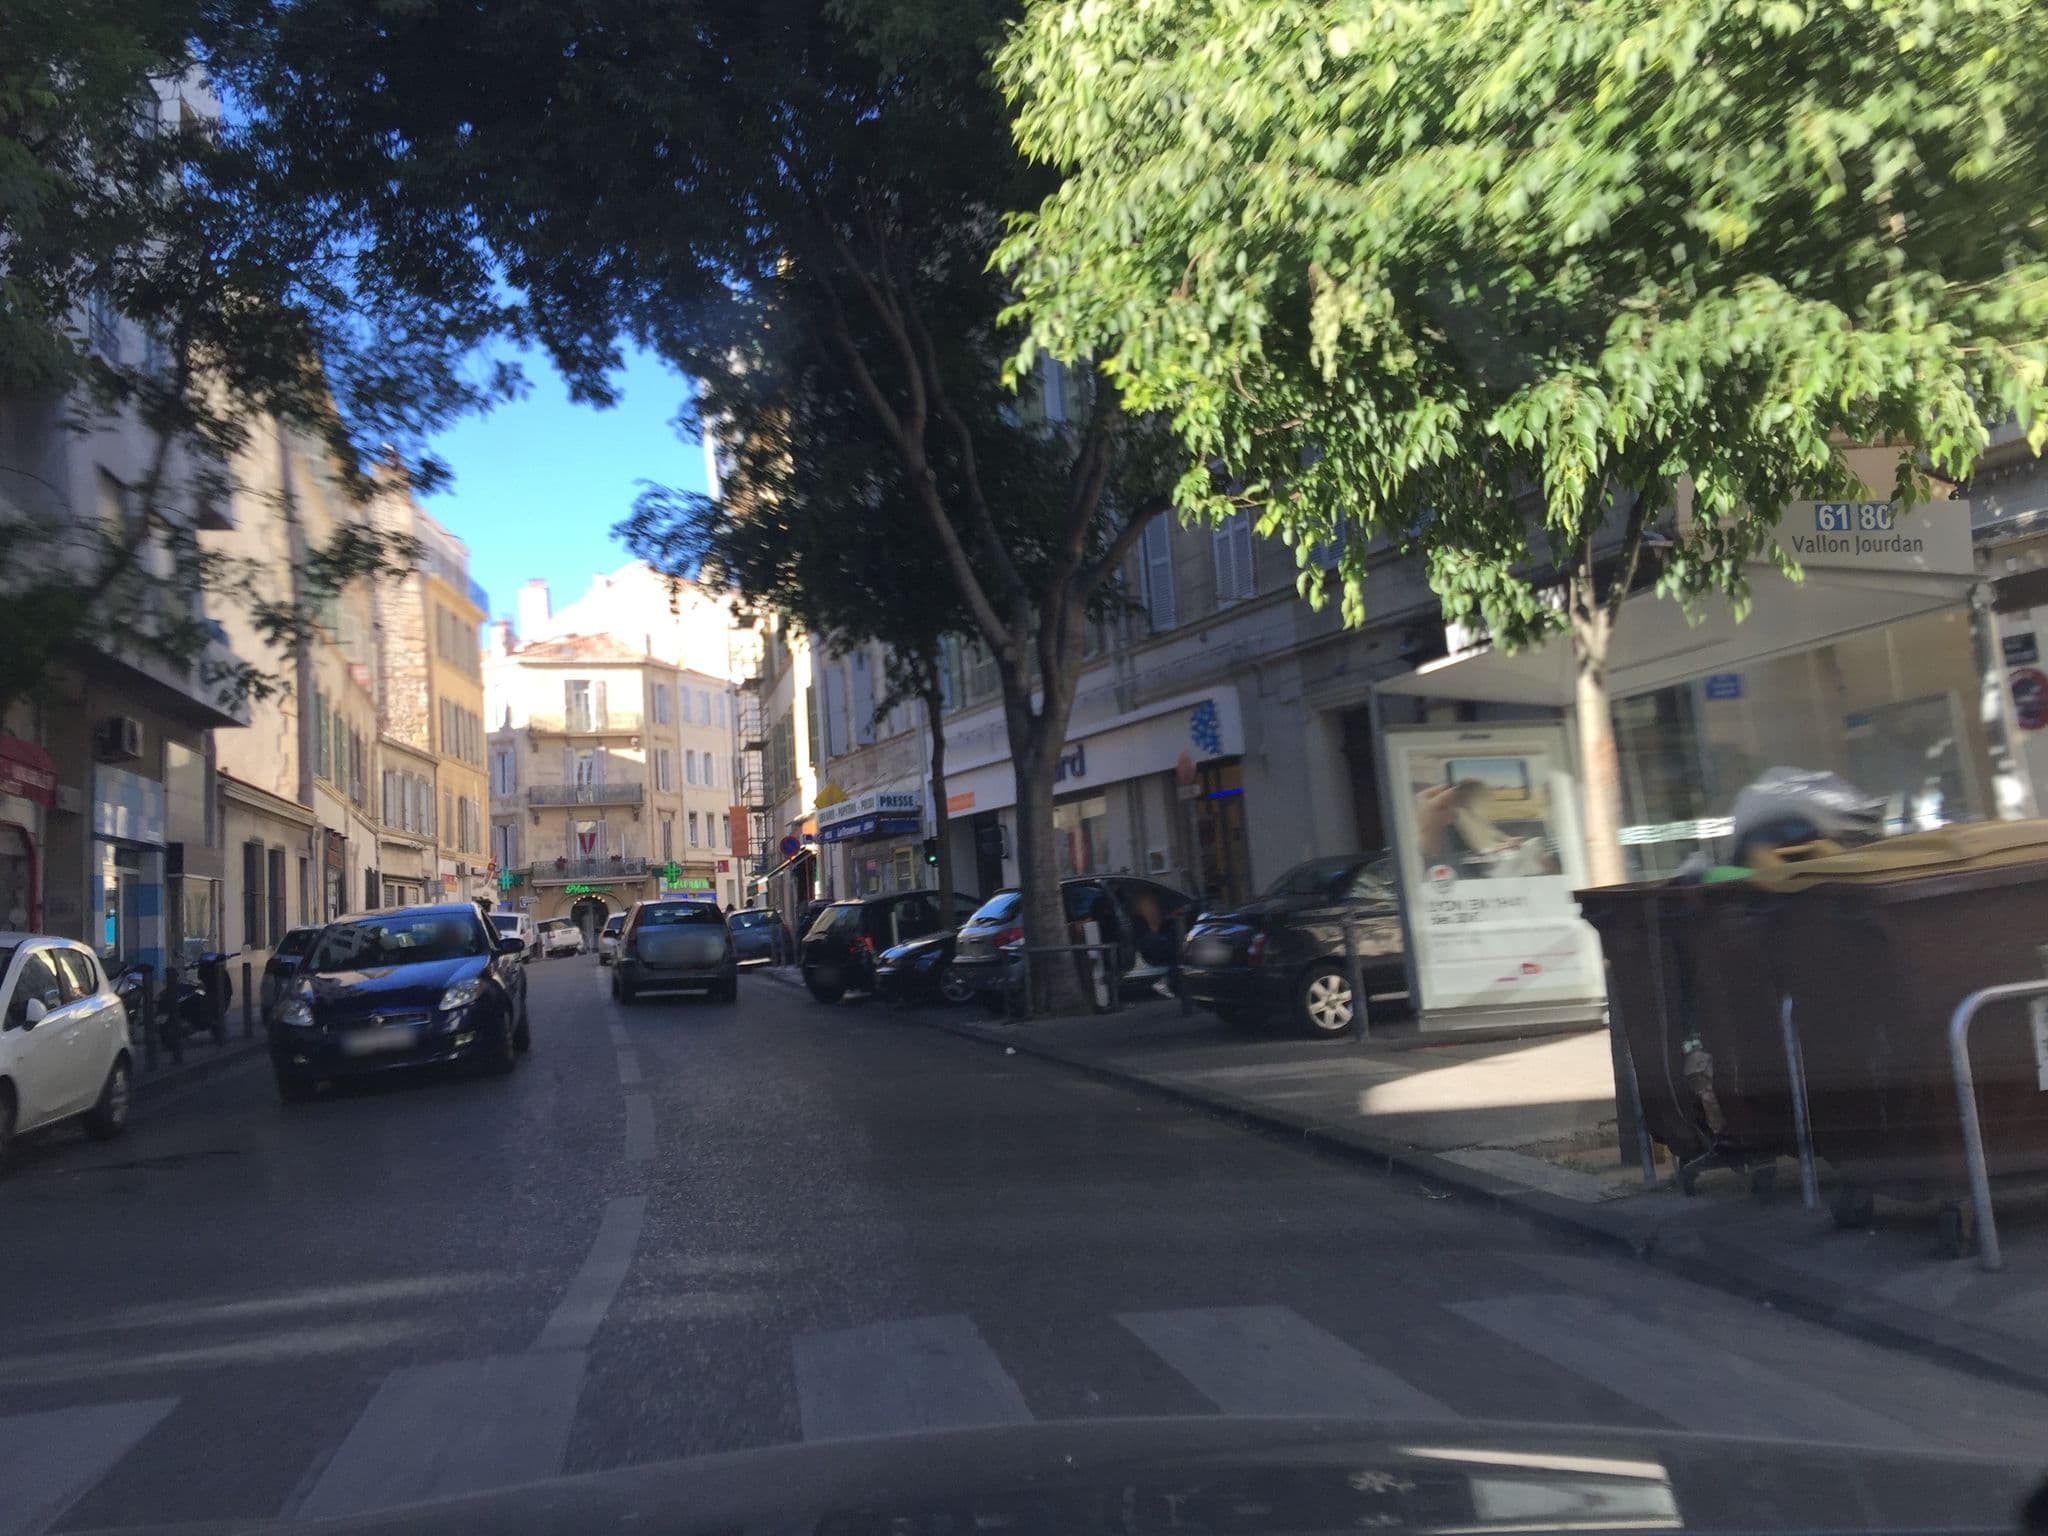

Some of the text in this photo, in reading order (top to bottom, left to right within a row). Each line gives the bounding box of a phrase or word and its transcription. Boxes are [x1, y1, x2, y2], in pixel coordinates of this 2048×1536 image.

[1819, 505, 1849, 530] 61
[1792, 534, 1923, 555] Vallon Jourdan
[880, 795, 914, 808] PRESSE
